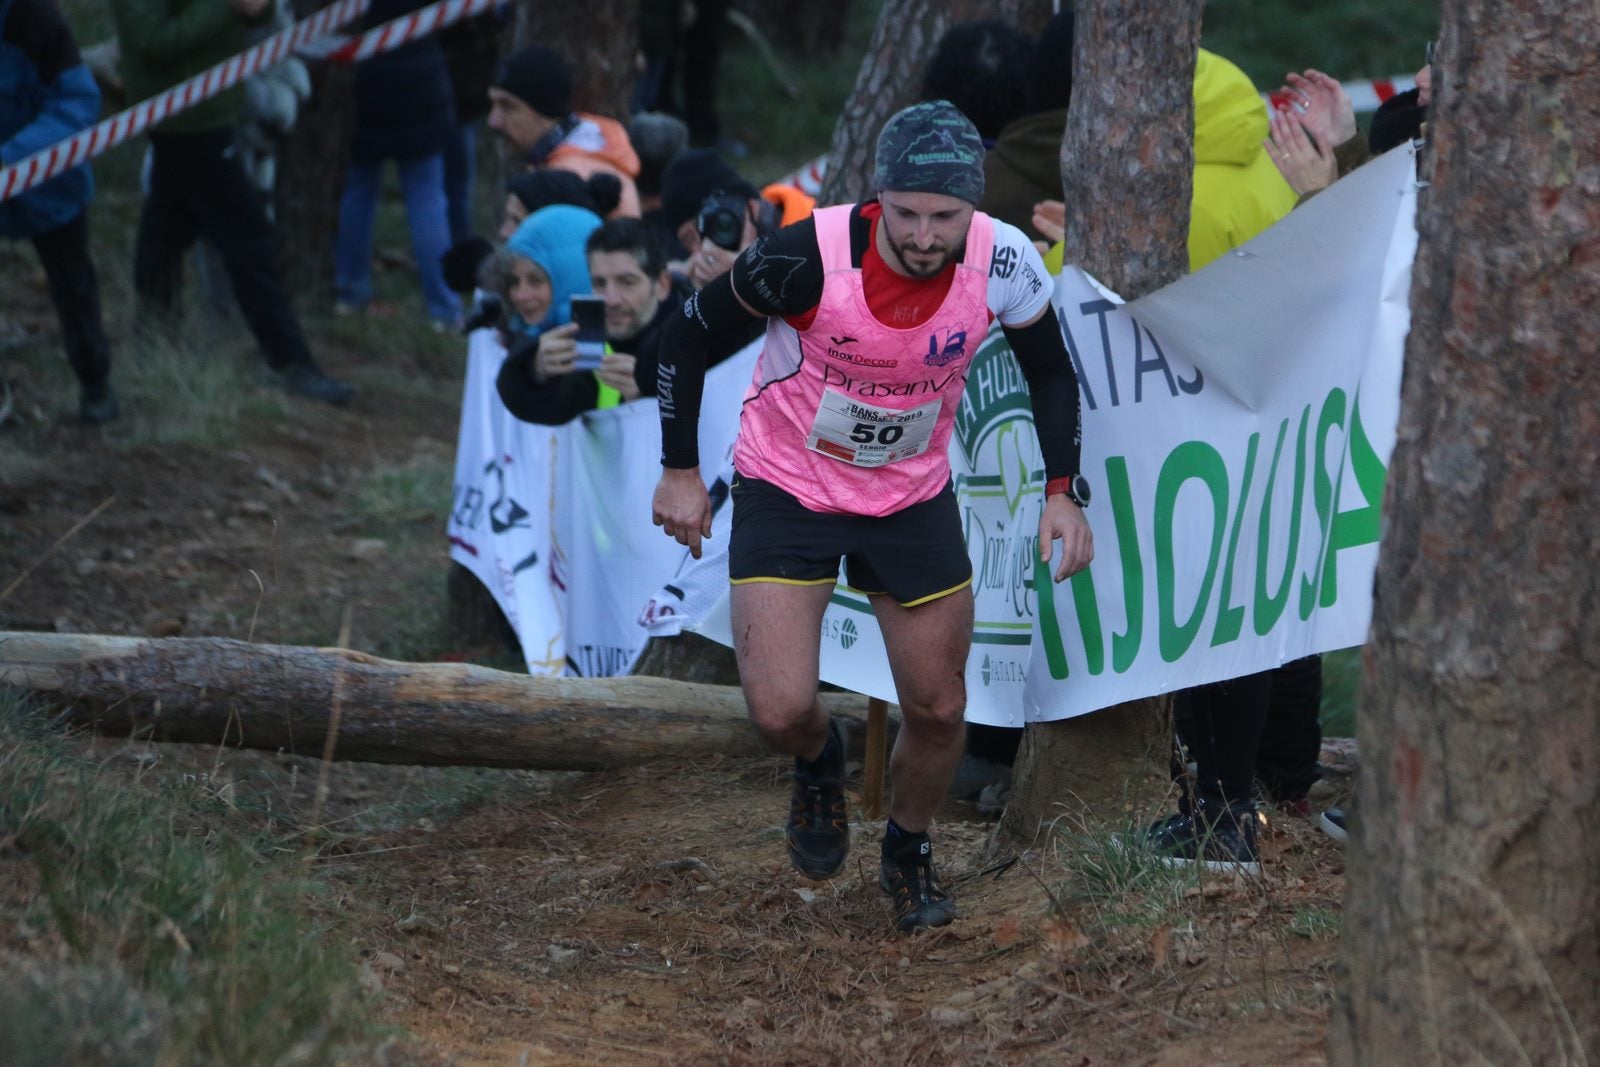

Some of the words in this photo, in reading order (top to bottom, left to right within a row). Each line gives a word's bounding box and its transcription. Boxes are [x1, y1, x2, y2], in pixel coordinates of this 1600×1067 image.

[657, 362, 677, 420] TRAIL
[897, 410, 923, 423] 2019
[849, 422, 904, 445] 50
